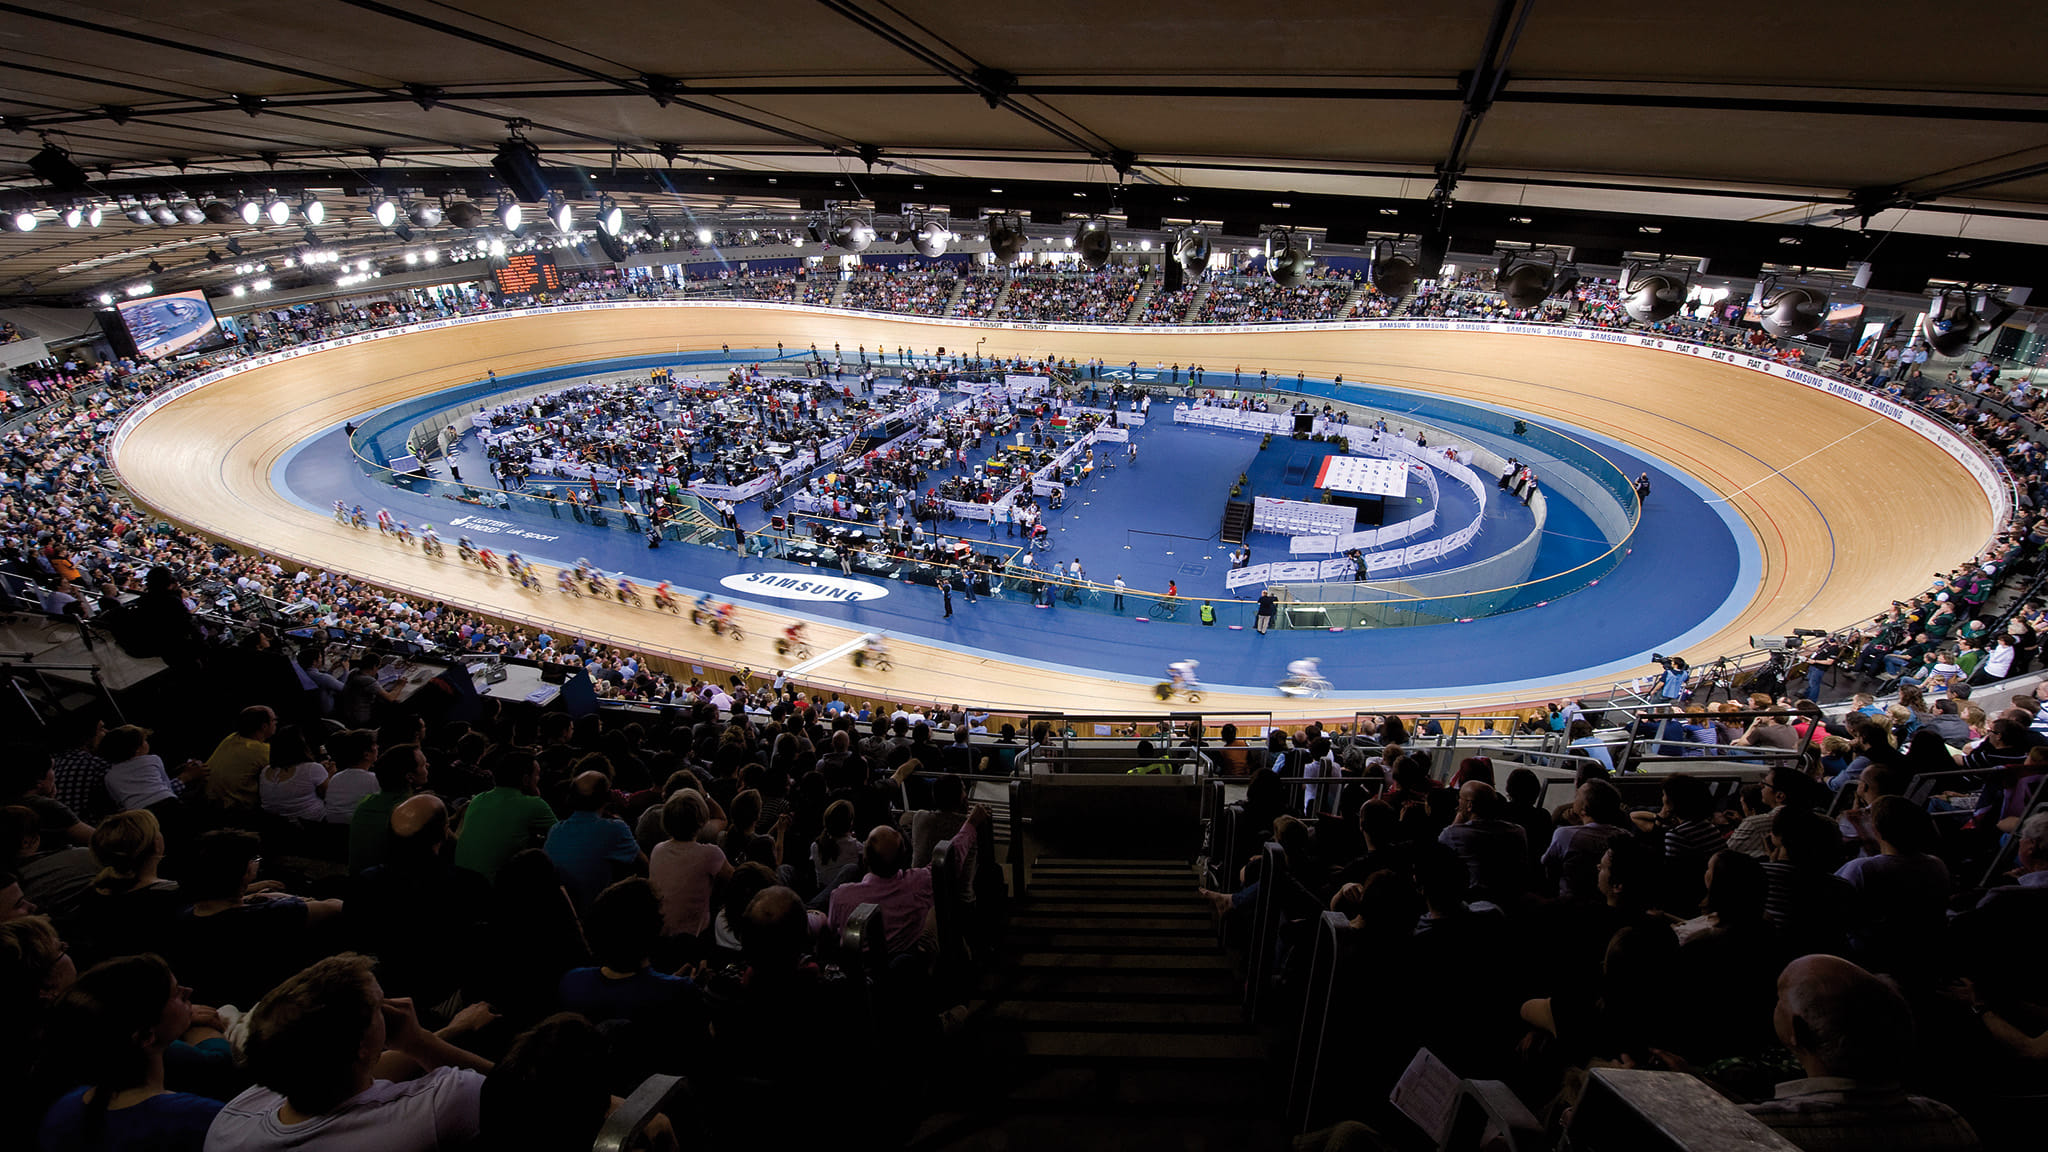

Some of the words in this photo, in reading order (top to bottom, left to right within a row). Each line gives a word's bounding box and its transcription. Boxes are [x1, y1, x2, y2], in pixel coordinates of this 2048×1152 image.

[1416, 322, 1449, 330] SAMSUNG
[1506, 326, 1542, 334] SAMSUNG
[1547, 329, 1583, 338] SAMSUNG
[1590, 332, 1628, 343] SAMSUNG
[1640, 338, 1655, 347] FIAT
[1675, 344, 1690, 353] FIAT
[1711, 350, 1726, 360] FIAT
[1747, 359, 1762, 369] FIAT
[1785, 369, 1824, 388] SAMSUNG
[1827, 382, 1864, 402] SAMSUNG
[1868, 398, 1904, 420] SAMSUNG
[460, 522, 500, 533] FUNDED
[471, 517, 514, 528] LOTTERY
[746, 572, 863, 601] SAMSUNG
